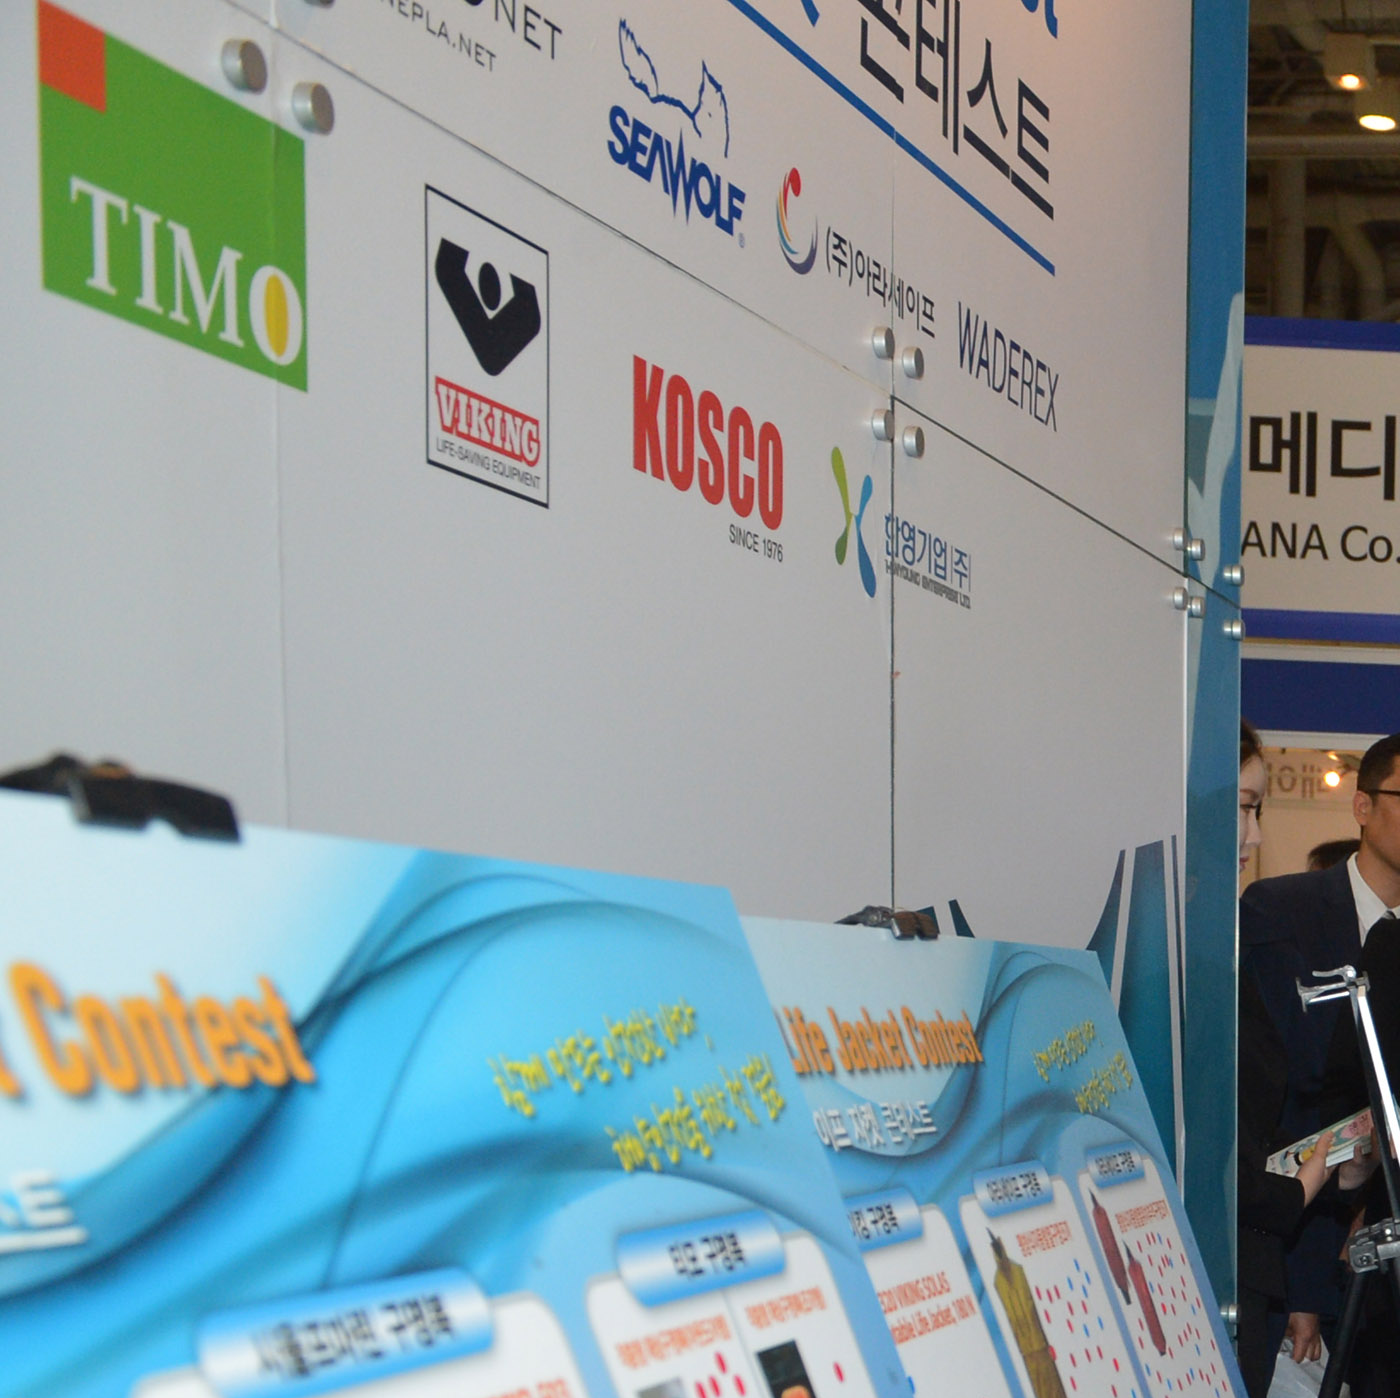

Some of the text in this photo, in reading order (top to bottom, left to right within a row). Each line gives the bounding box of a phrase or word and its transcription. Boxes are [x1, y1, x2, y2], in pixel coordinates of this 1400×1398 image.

[607, 105, 746, 237] SEAWOLF
[70, 174, 303, 366] TIMO
[826, 226, 936, 338] (주)아라세이프
[436, 378, 540, 466] VIKING
[958, 301, 1060, 432] WADEREX
[633, 354, 783, 530] KOSCO
[729, 523, 783, 562] SINCE 1976
[9, 961, 317, 1097] Contest
[827, 1005, 914, 1073] Jacket
[900, 1005, 983, 1068] Contest
